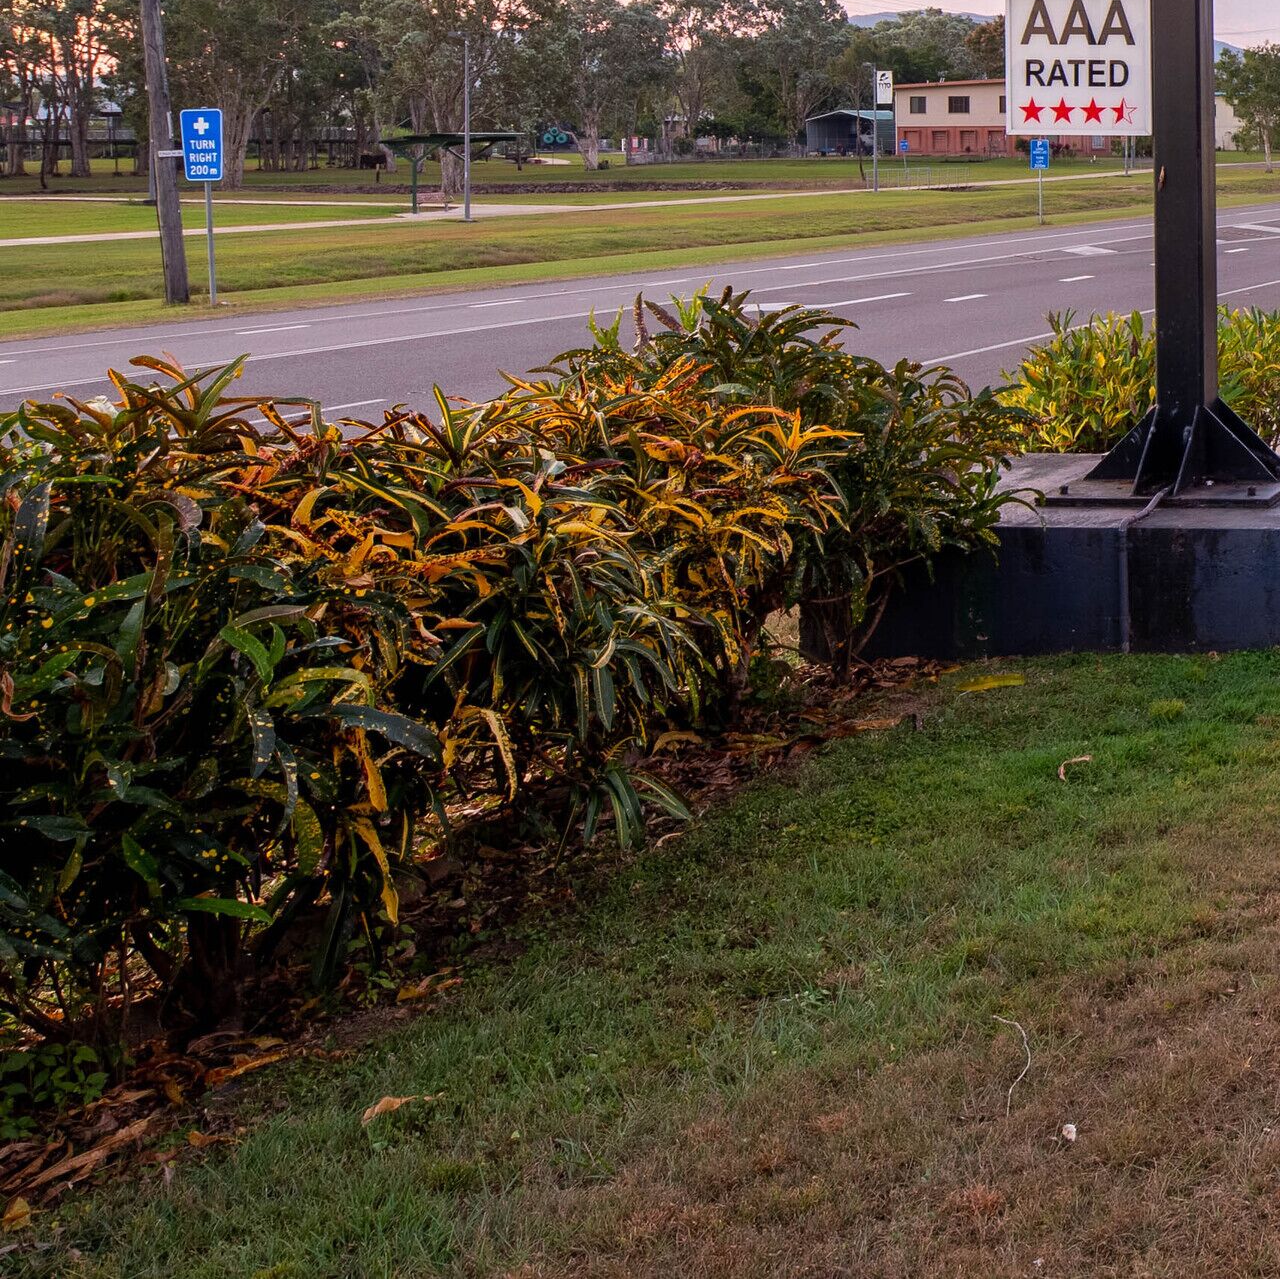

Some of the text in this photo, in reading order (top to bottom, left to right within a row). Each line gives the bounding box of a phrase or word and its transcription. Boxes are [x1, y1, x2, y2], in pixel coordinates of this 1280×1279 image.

[1019, 0, 1136, 47] AAA
[1024, 58, 1130, 88] RATED
[190, 140, 215, 149] TURN
[189, 153, 217, 163] RIGHT
[190, 165, 208, 175] 200
